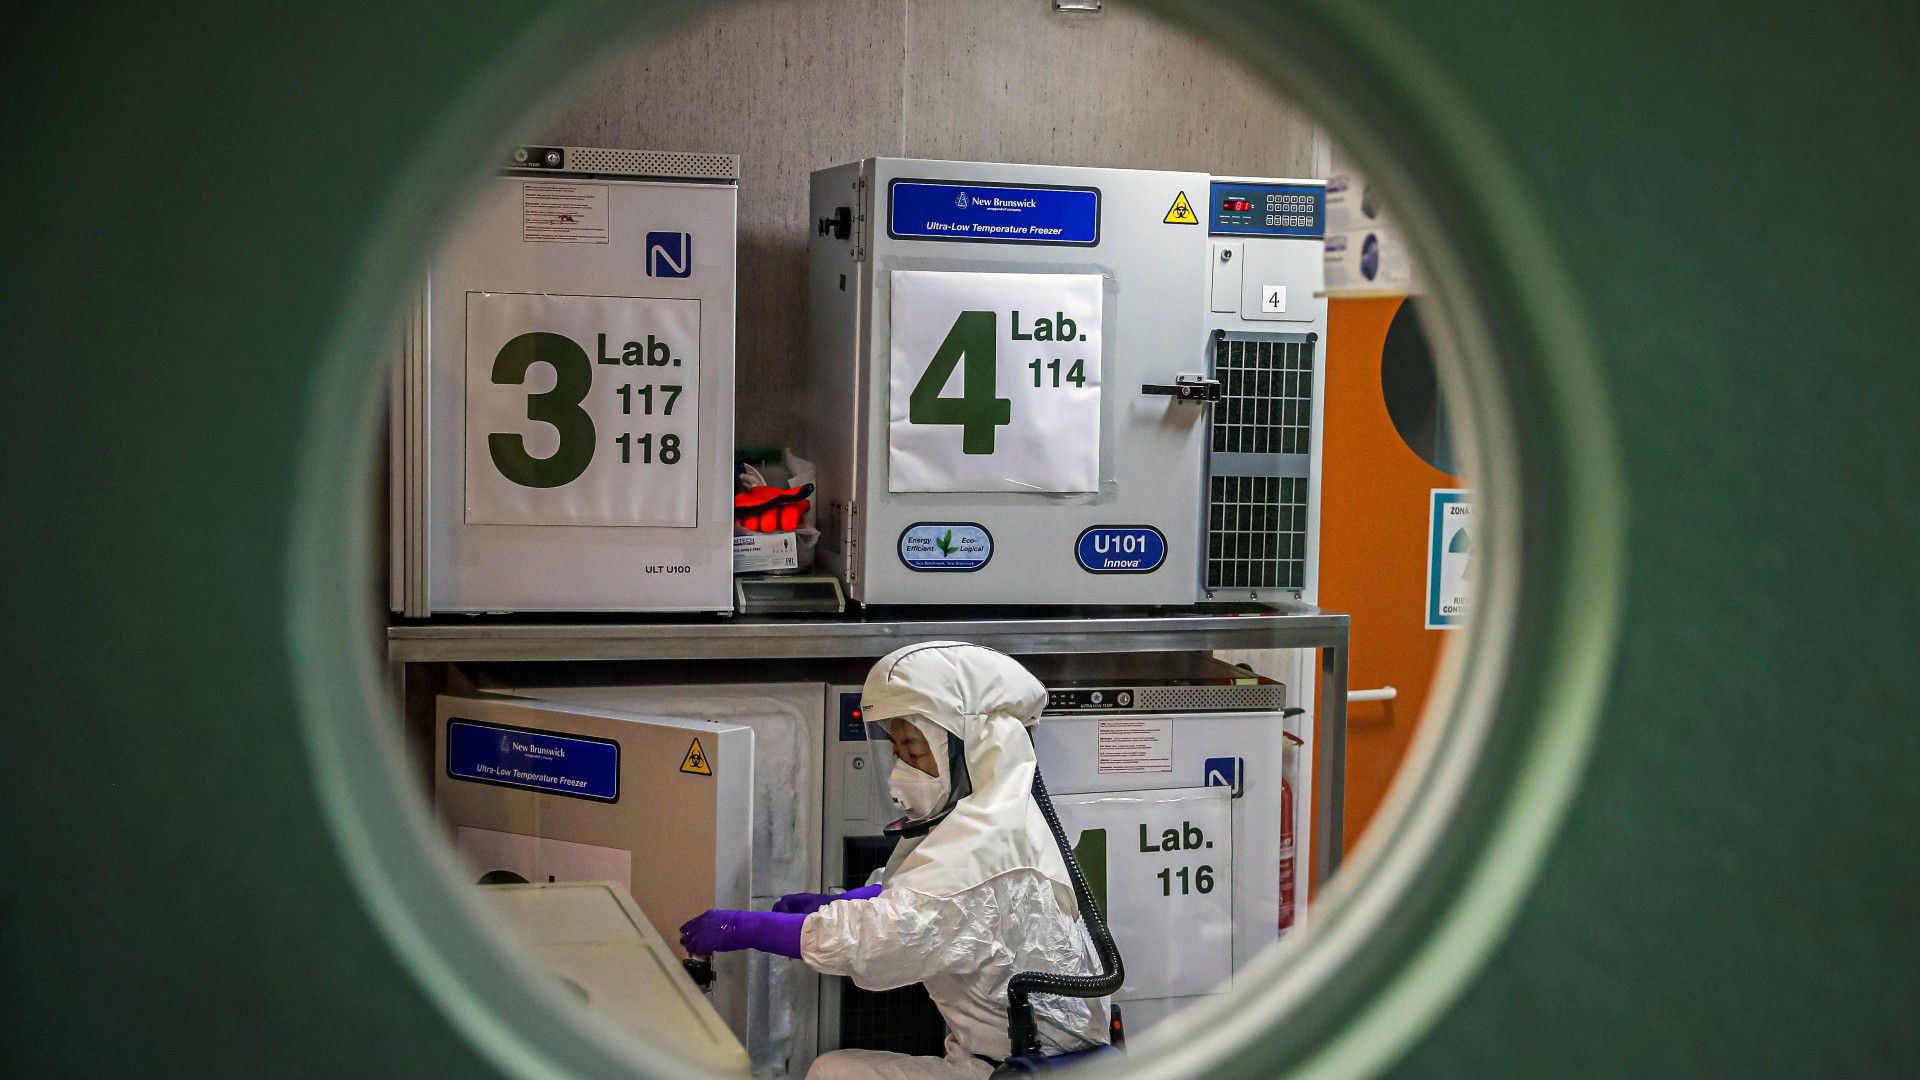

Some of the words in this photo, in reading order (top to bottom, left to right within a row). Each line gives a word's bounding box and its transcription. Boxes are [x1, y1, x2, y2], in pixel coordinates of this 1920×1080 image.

[972, 196, 992, 206] New
[993, 197, 1037, 208] Brunswick
[926, 221, 970, 231] Ultra-Low
[972, 223, 1028, 234] Temperature
[1029, 226, 1062, 235] Freezer
[1268, 291, 1280, 308] 4
[1011, 310, 1087, 342] Lab.
[597, 333, 682, 367] Lab.
[909, 310, 1011, 455] 4
[1028, 358, 1086, 388] 114
[488, 331, 597, 489] 3
[616, 384, 683, 416] 117
[615, 433, 681, 465] 118
[1450, 506, 1470, 515] ZONA
[908, 537, 931, 545] Energy
[1094, 534, 1145, 553] U101
[645, 565, 664, 573] ULT
[666, 565, 691, 573] U100
[1443, 605, 1463, 613] CONT
[512, 741, 528, 752] New
[530, 744, 565, 758] Brunswick
[476, 763, 511, 776] Ultra-Low
[513, 769, 558, 784] Temperature
[559, 776, 588, 788] Freezer
[1139, 821, 1213, 852] Lab.
[1157, 865, 1214, 896] 116
